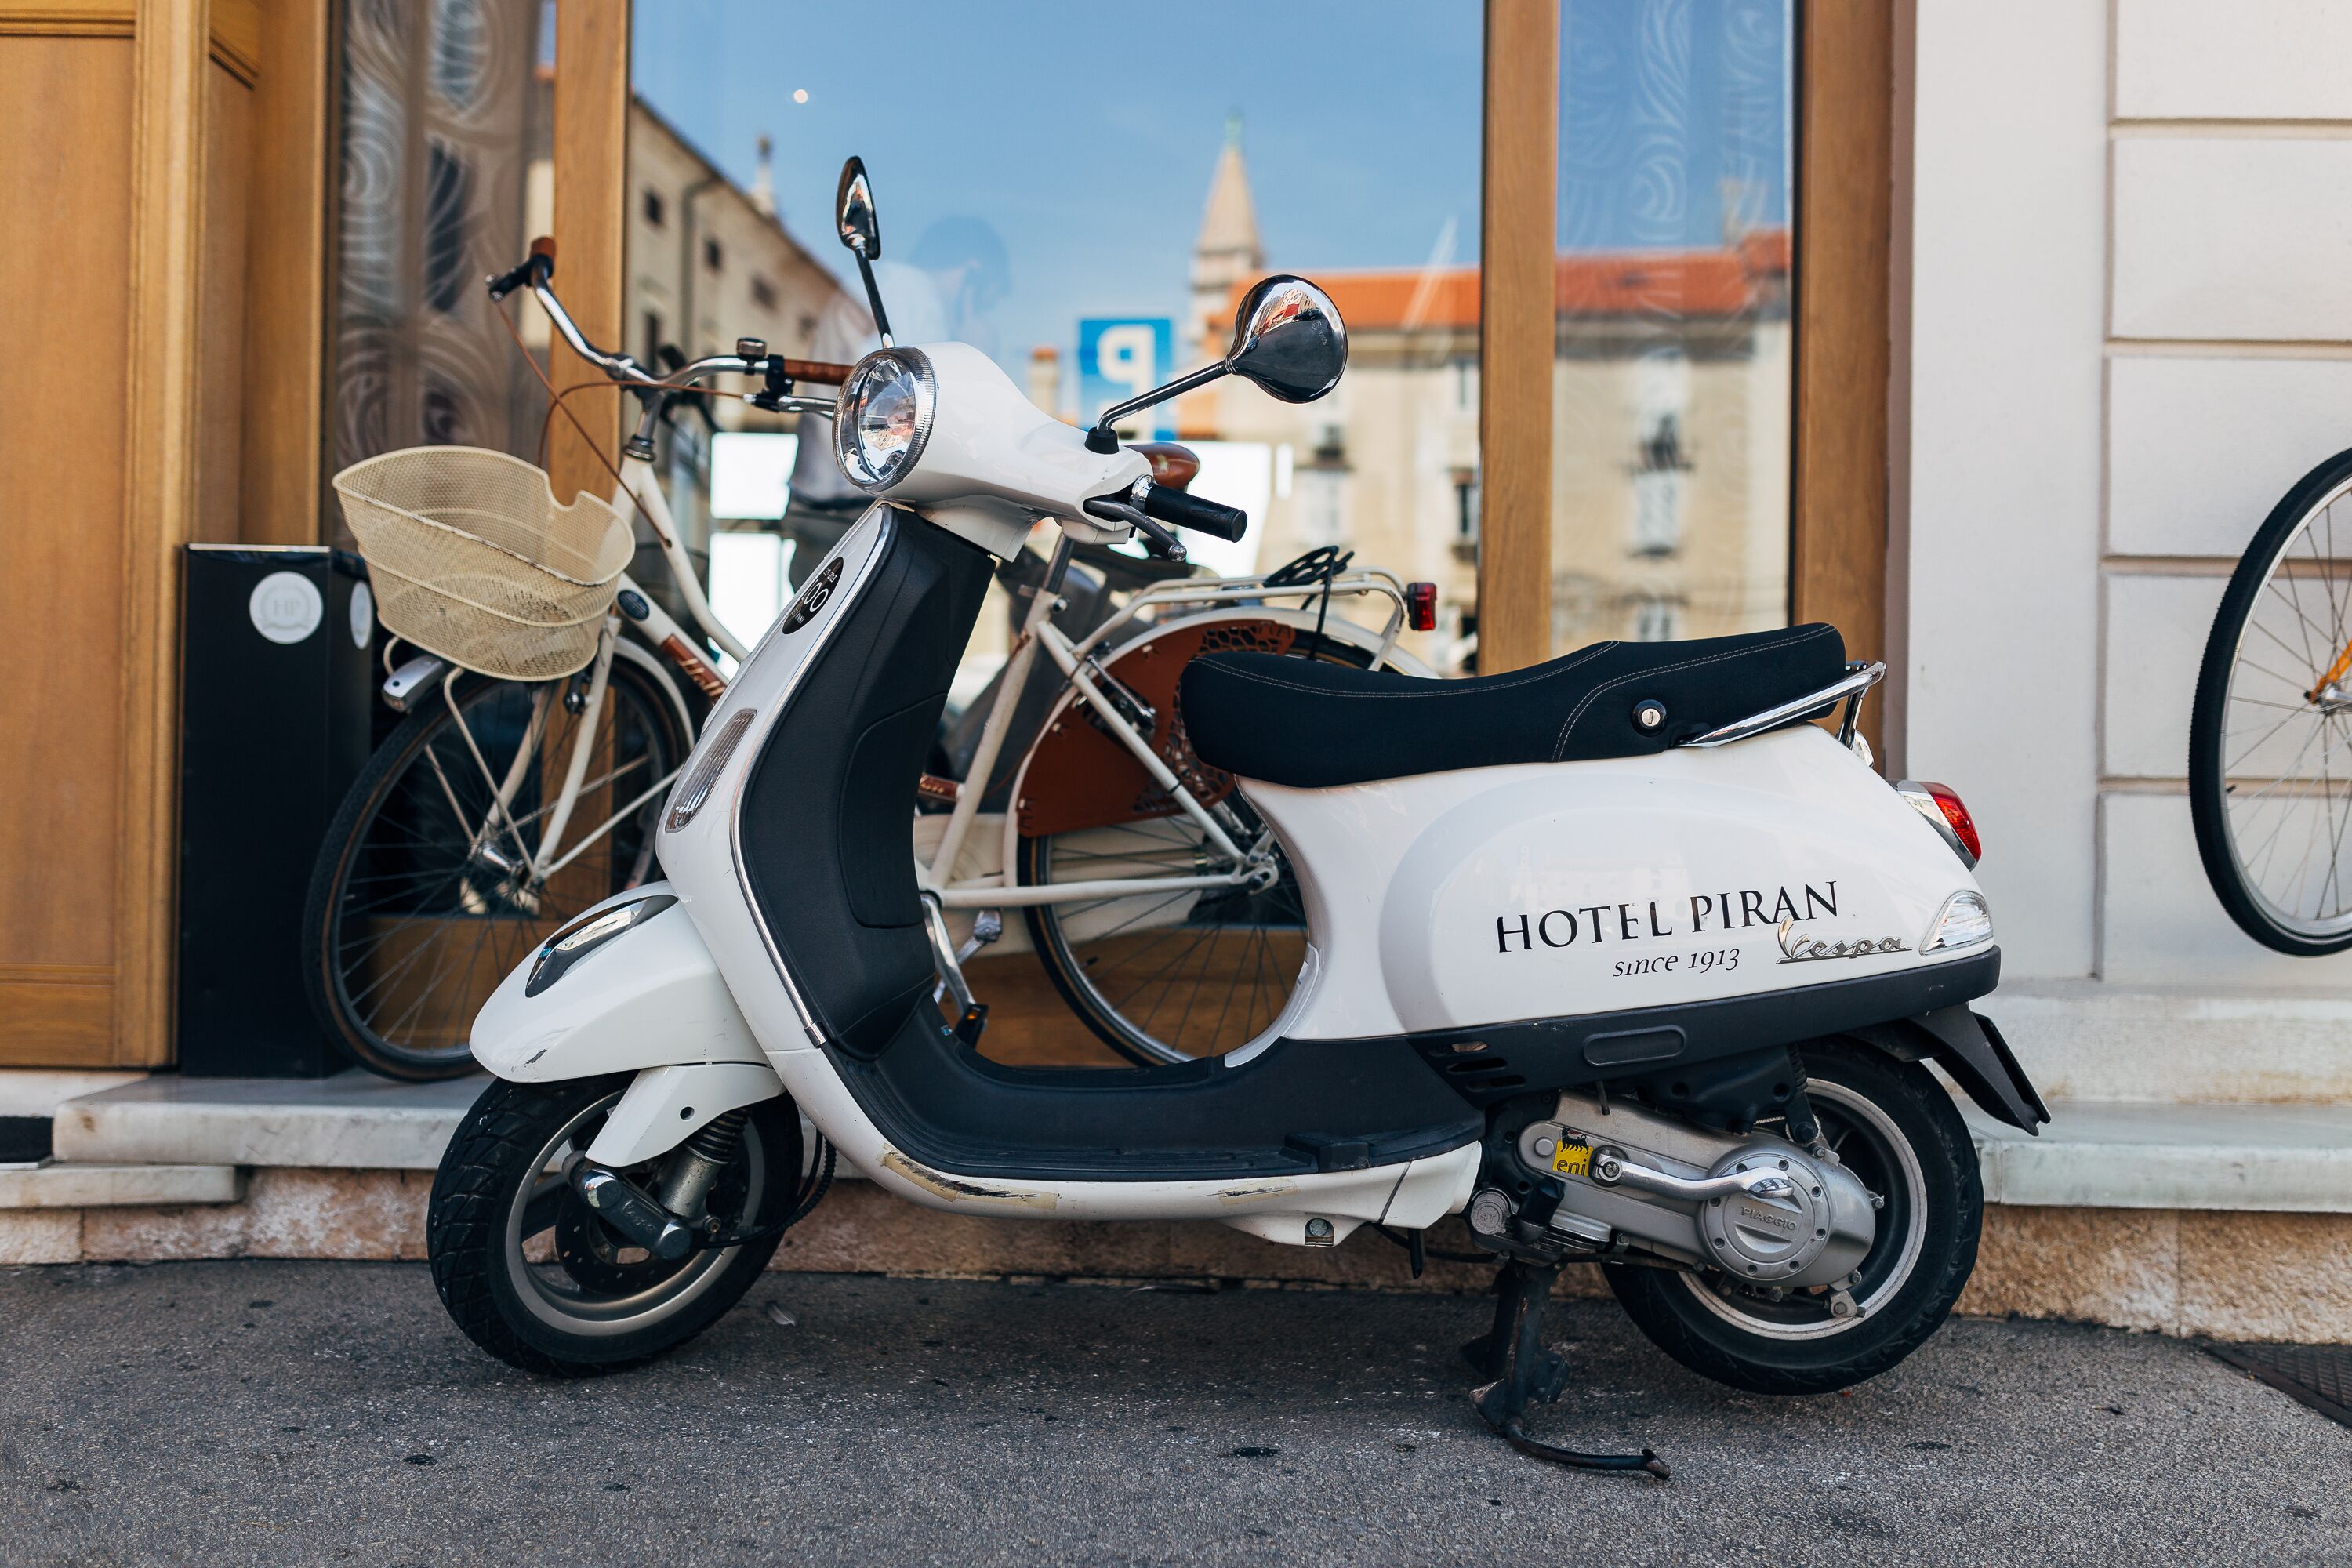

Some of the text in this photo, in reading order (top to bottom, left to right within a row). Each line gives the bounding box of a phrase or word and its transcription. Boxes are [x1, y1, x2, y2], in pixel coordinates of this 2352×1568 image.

[1497, 880, 1838, 953] HOTEL PIRAN
[1775, 914, 1913, 965] Vespa
[1613, 948, 1740, 978] since 1913
[1556, 1158, 1587, 1176] eni
[1740, 1206, 1797, 1231] PIAGGIO
